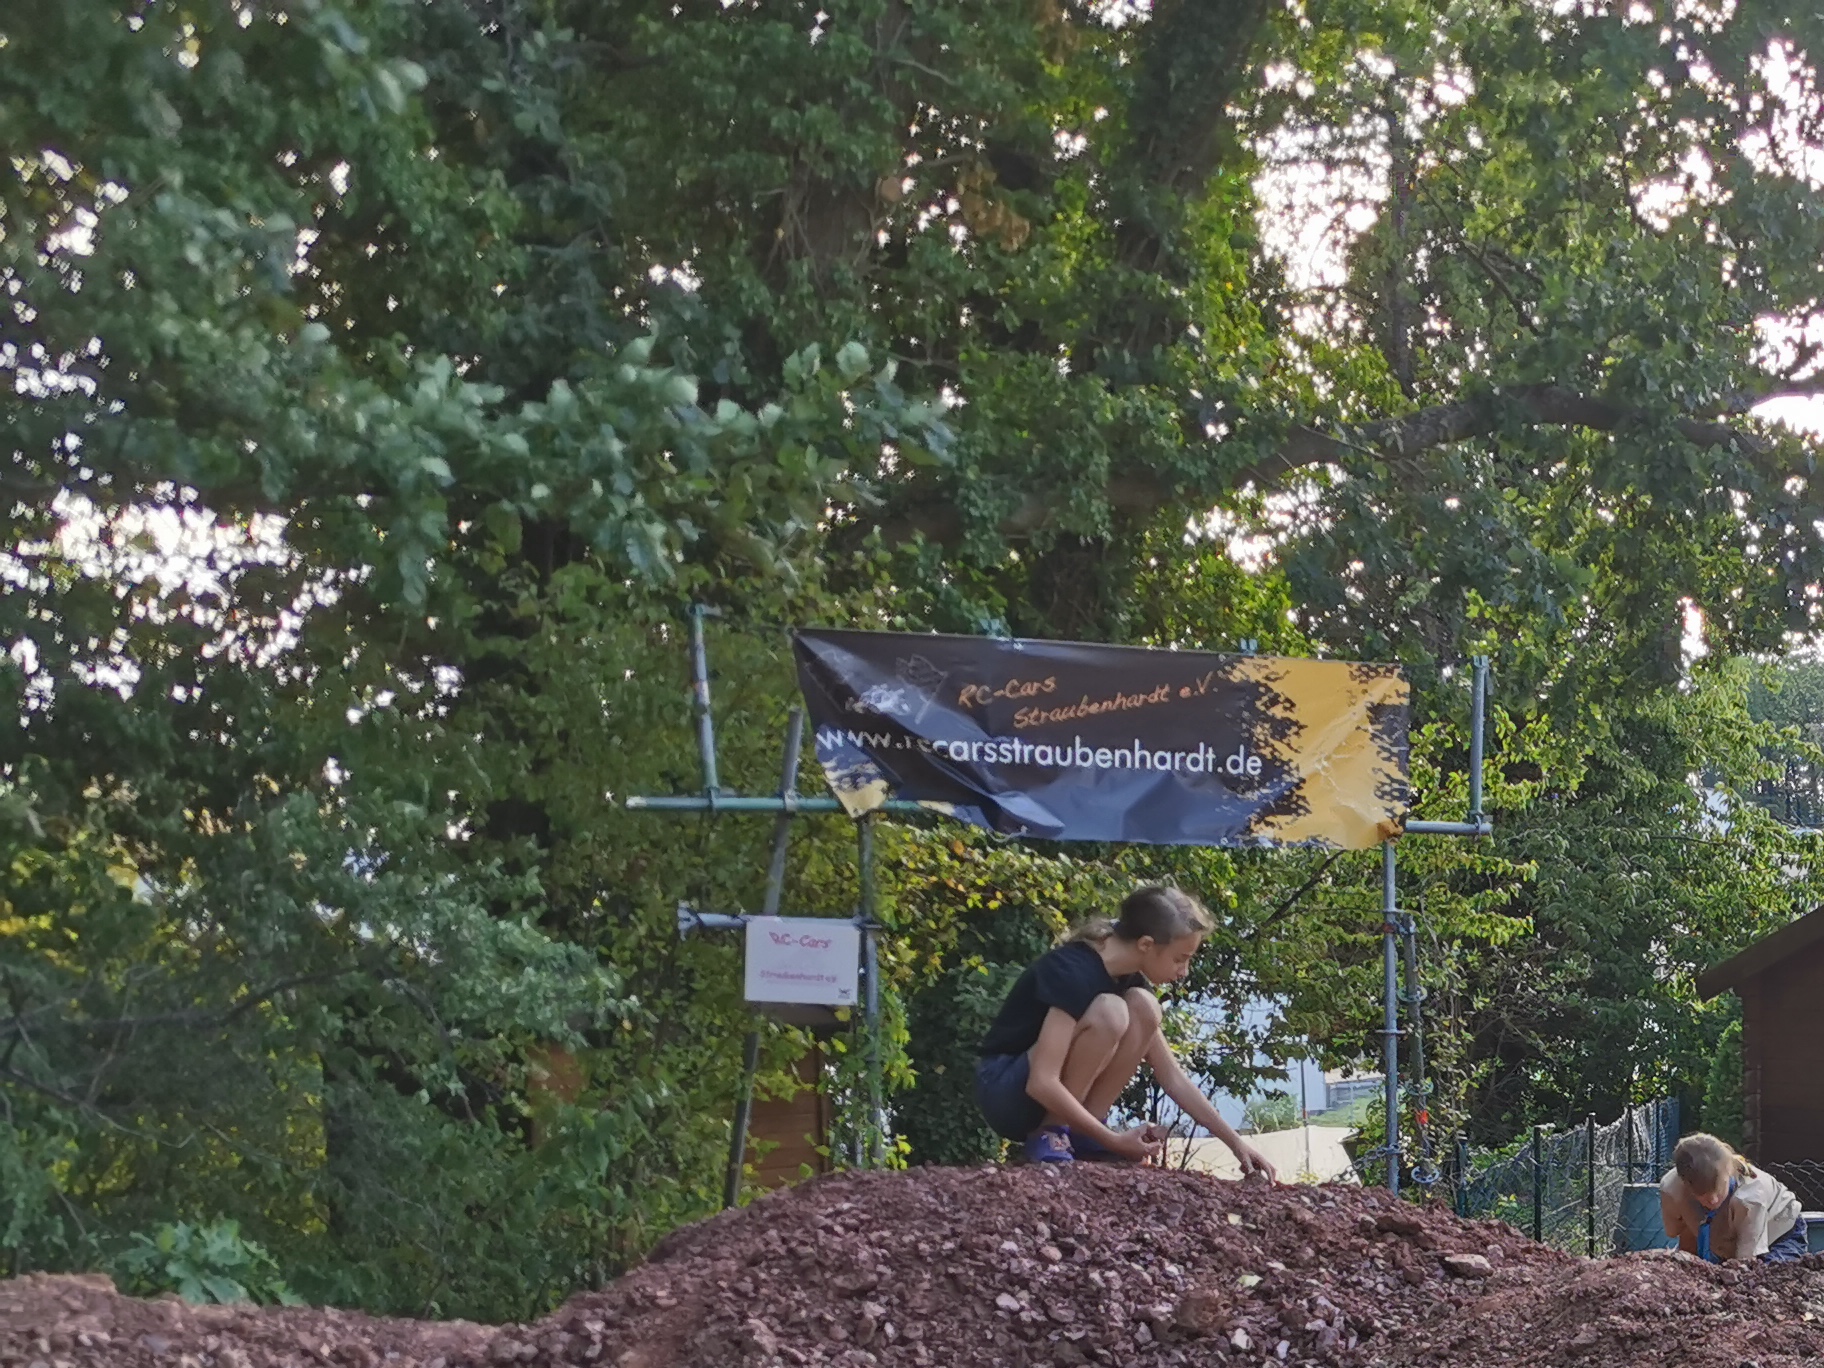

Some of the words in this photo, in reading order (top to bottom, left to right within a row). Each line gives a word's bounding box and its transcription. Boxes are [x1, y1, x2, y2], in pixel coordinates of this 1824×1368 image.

[958, 675, 1057, 709] RC-Cars
[1013, 682, 1170, 729] Straubenhardt
[1178, 670, 1219, 699] e.V.
